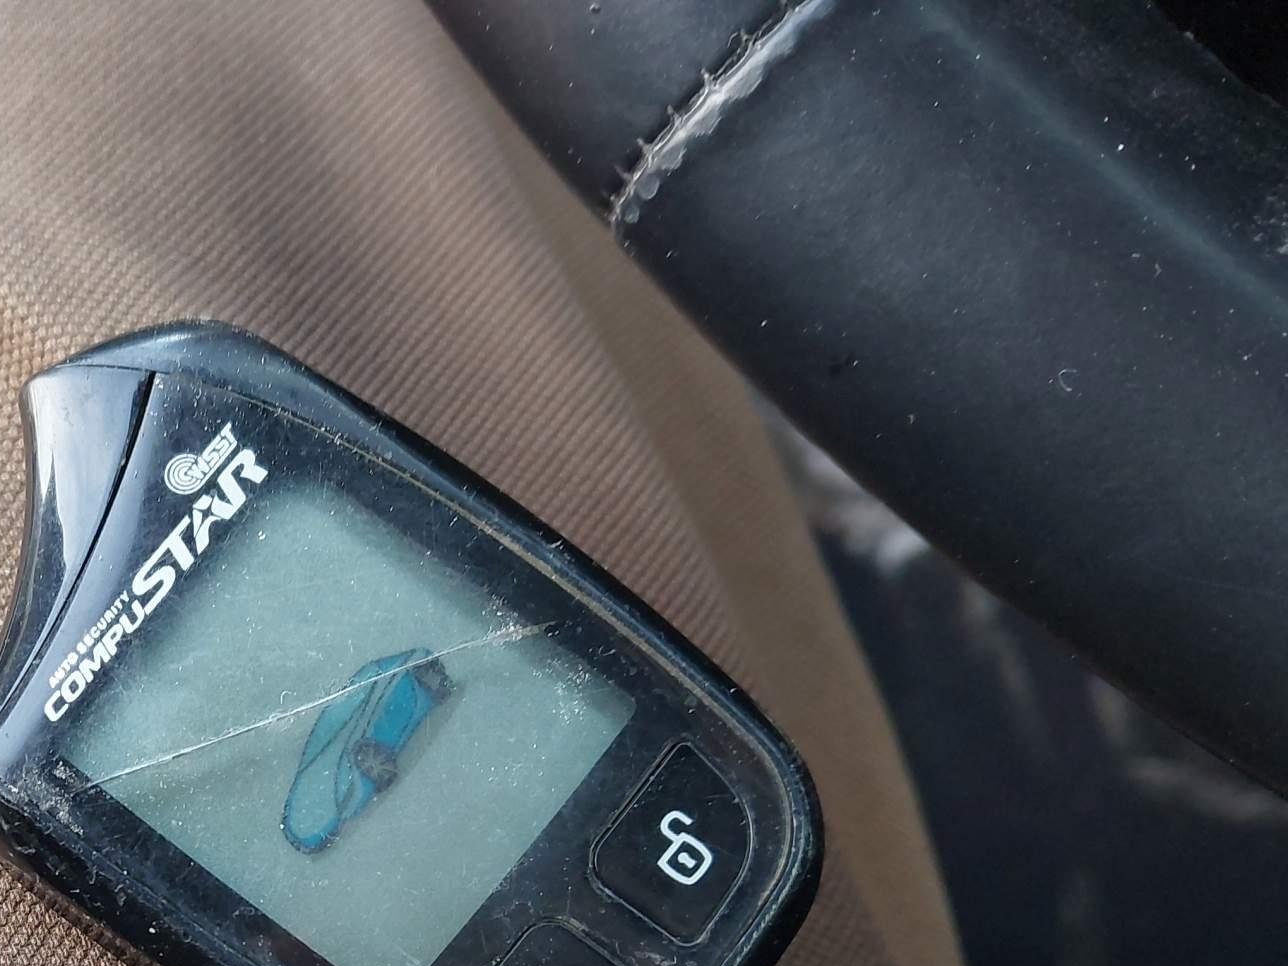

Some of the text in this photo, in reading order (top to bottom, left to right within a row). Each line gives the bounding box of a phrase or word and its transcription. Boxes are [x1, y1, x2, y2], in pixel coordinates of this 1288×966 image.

[43, 448, 269, 722] COMPUSTAR
[48, 589, 130, 689] AUTO SECURITY
